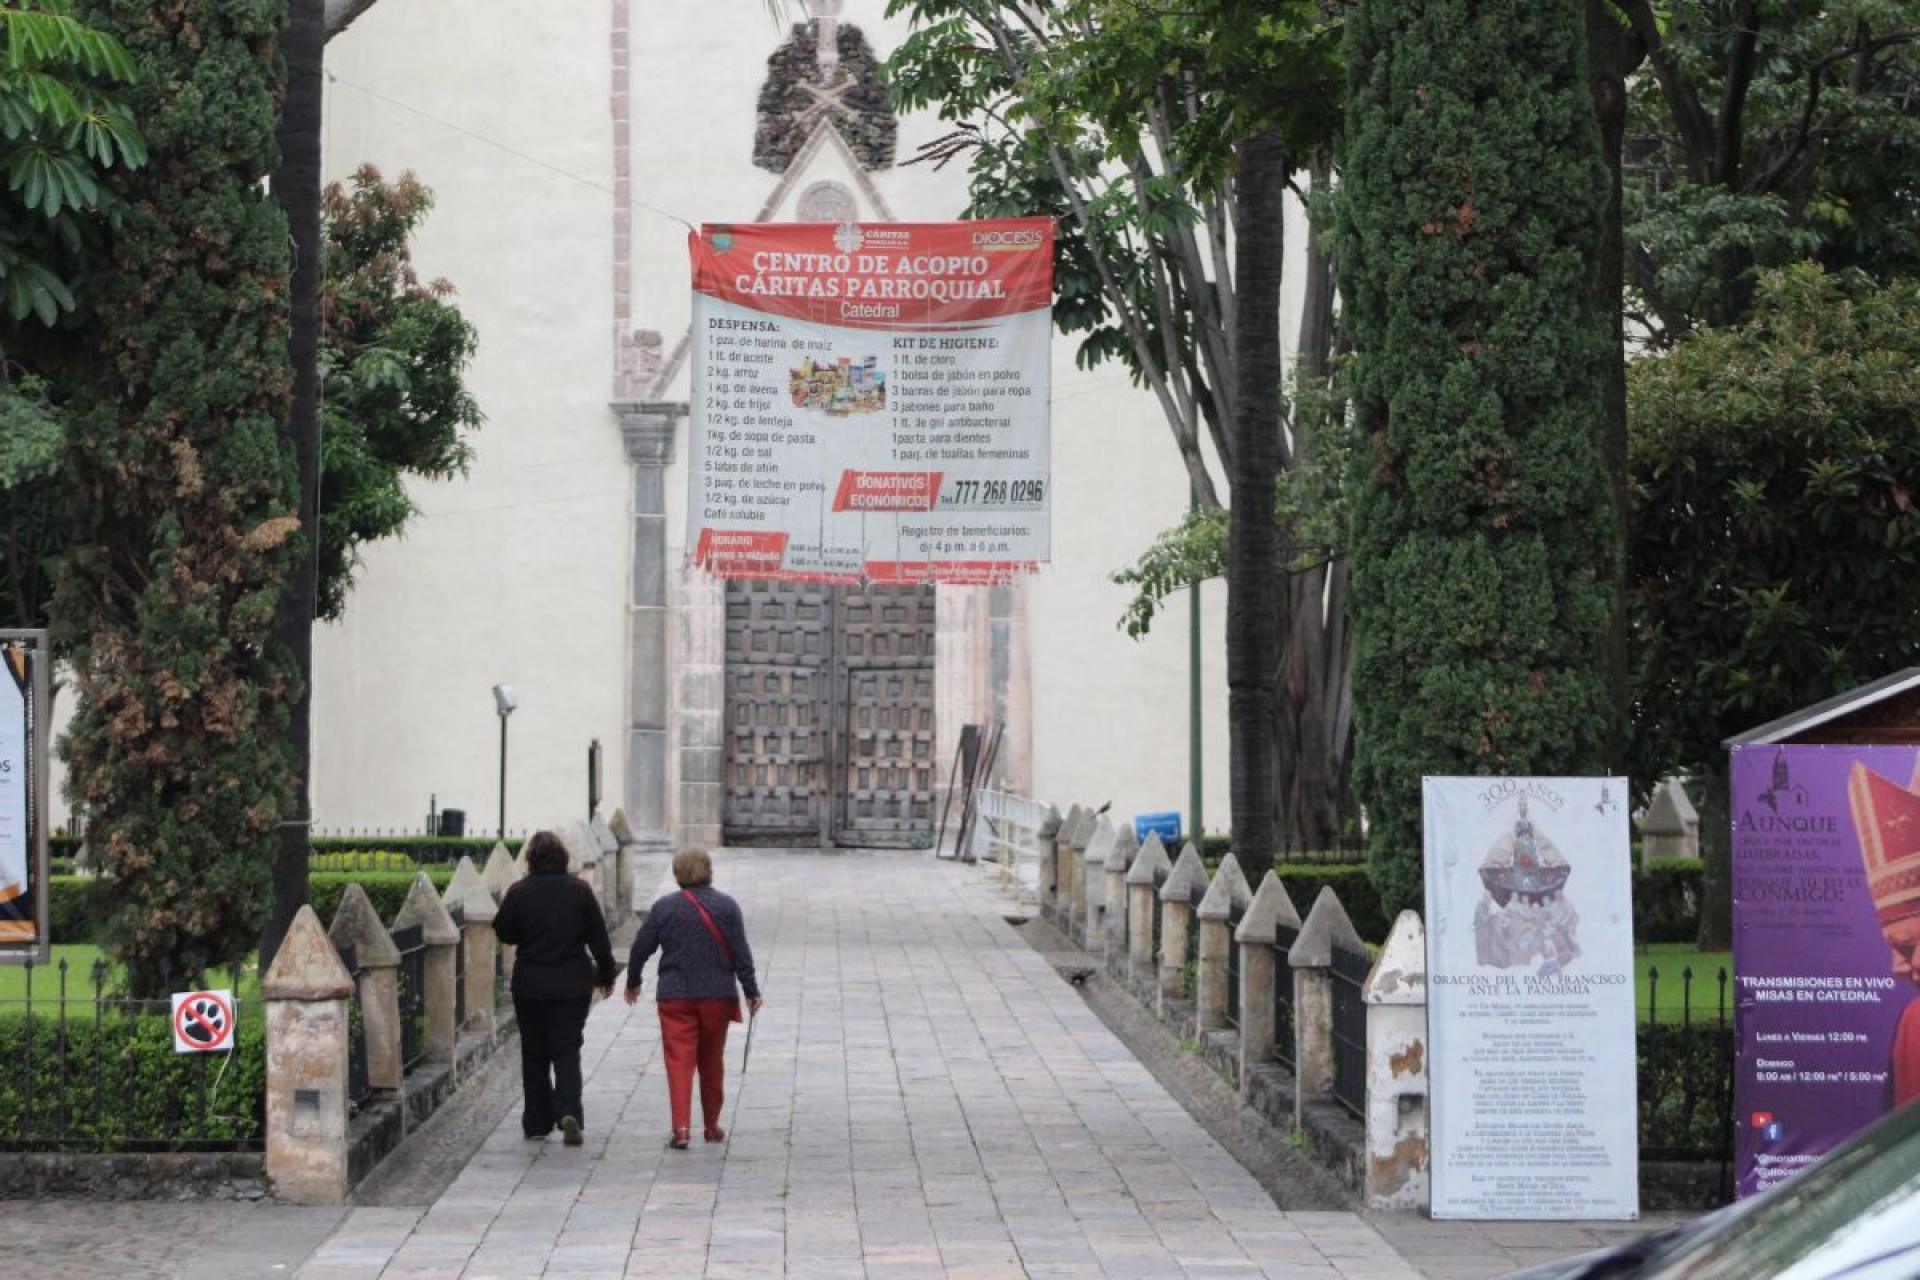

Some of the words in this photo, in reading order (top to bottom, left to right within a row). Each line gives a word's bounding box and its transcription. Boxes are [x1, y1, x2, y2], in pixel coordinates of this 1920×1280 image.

[753, 252, 849, 275] CENTRO
[858, 255, 891, 275] DE
[900, 255, 988, 276] ACOPIO
[735, 272, 838, 298] CÁRITAS
[846, 277, 1006, 303] PARROQUIAL
[840, 302, 900, 318] Catedral
[709, 318, 780, 331] DESPENSA:
[739, 337, 752, 347] de
[755, 337, 786, 348] harina
[792, 339, 806, 349] de
[893, 338, 915, 348] KIT
[919, 338, 936, 348] DE
[939, 338, 998, 349] HIGIENE:
[729, 352, 741, 362] de
[915, 354, 927, 364] de
[930, 354, 955, 364] cloro
[707, 367, 714, 377] 2
[734, 368, 759, 378] arroz
[902, 370, 928, 380] bolsa
[931, 370, 944, 380] de
[979, 371, 990, 380] en
[993, 370, 1021, 381] polvo
[734, 383, 746, 393] de
[750, 385, 778, 394] avena
[892, 386, 898, 396] 3
[902, 386, 934, 396] barras
[937, 386, 950, 396] de
[983, 388, 1005, 398] para
[706, 398, 714, 408] 2
[734, 398, 746, 409] de
[891, 402, 898, 412] 3
[900, 401, 940, 415] jabones
[944, 403, 966, 414] para
[968, 401, 994, 412] baño
[743, 414, 755, 425] de
[758, 415, 792, 429] lenteja
[914, 417, 926, 427] de
[948, 416, 1010, 428] antibacterial
[729, 430, 742, 441] de
[744, 432, 768, 443] sopa
[771, 431, 784, 442] de
[786, 433, 815, 446] pasta
[954, 433, 991, 444] dientes
[742, 446, 754, 457] de
[758, 446, 772, 458] sal
[925, 448, 938, 459] de
[941, 448, 974, 460] toallas
[978, 448, 1030, 460] femeninas
[705, 461, 712, 471] 5
[714, 461, 738, 472] latas
[740, 462, 752, 472] de
[704, 477, 712, 487] 3
[739, 478, 750, 488] de
[753, 478, 780, 489] leche
[784, 481, 796, 490] en
[800, 480, 826, 492] polvo
[857, 476, 924, 489] DONATIVOS
[954, 481, 980, 504] 777
[983, 481, 1008, 504] 268
[1010, 480, 1044, 502] 0296
[742, 493, 754, 504] de
[850, 493, 928, 508] ECONÓMICOS
[729, 509, 766, 521] soluble
[902, 526, 943, 538] Registro
[946, 525, 959, 536] de
[962, 524, 1030, 536] beneficiarios:
[934, 541, 942, 551] 4
[1433, 974, 1490, 985] ORACIÓN
[1496, 975, 1516, 985] DEL
[1524, 975, 1552, 985] PAPA
[1558, 974, 1626, 985] FRANCISCO
[1742, 976, 1842, 988] TRANSMISIONES
[1846, 978, 1862, 988] EN
[1866, 978, 1894, 988] VIVO
[1468, 986, 1499, 996] ANTE
[1506, 986, 1521, 996] LA
[1528, 984, 1590, 996] PANDEMIA
[1756, 990, 1793, 1001] MISAS
[1796, 990, 1813, 1001] EN
[1816, 990, 1880, 1002] CATEDRAL
[1828, 1032, 1854, 1041] 12:00
